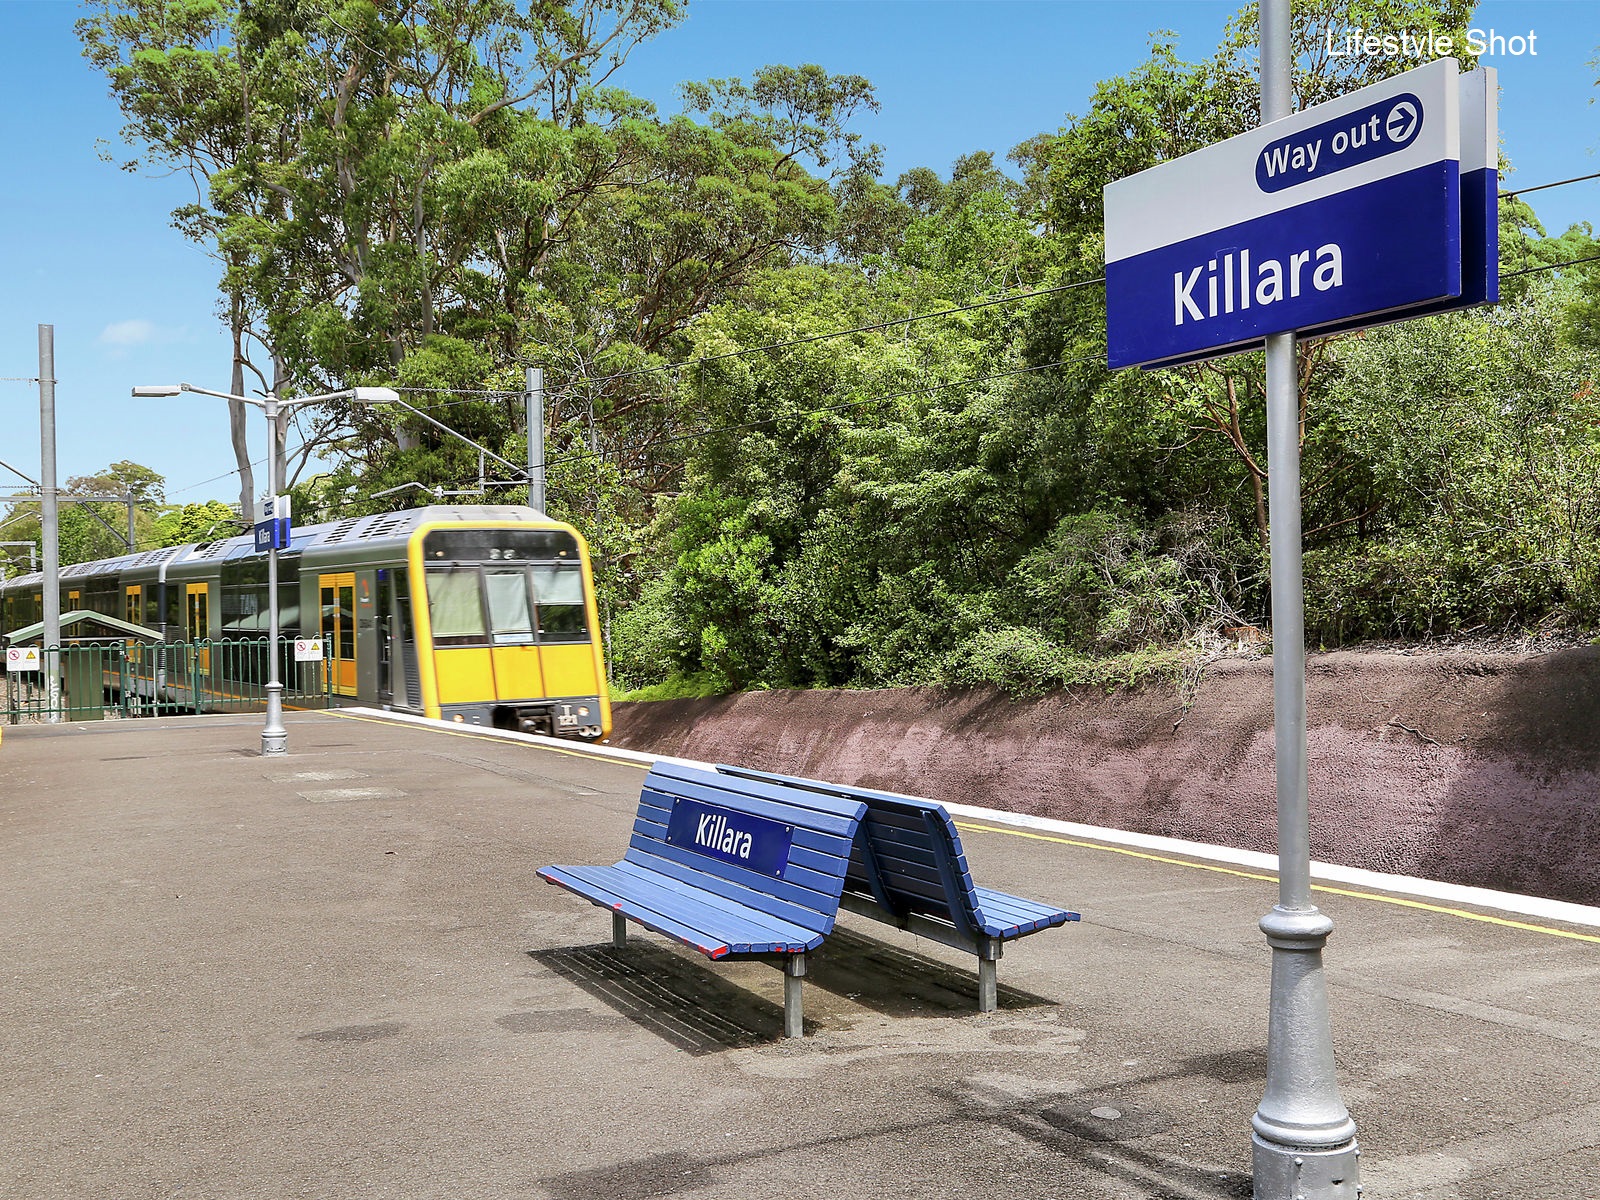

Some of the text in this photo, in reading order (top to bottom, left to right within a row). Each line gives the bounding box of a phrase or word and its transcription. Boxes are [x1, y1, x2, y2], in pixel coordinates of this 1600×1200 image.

[1263, 114, 1381, 178] Way out
[1174, 243, 1343, 326] Killara
[695, 813, 753, 859] Killara
